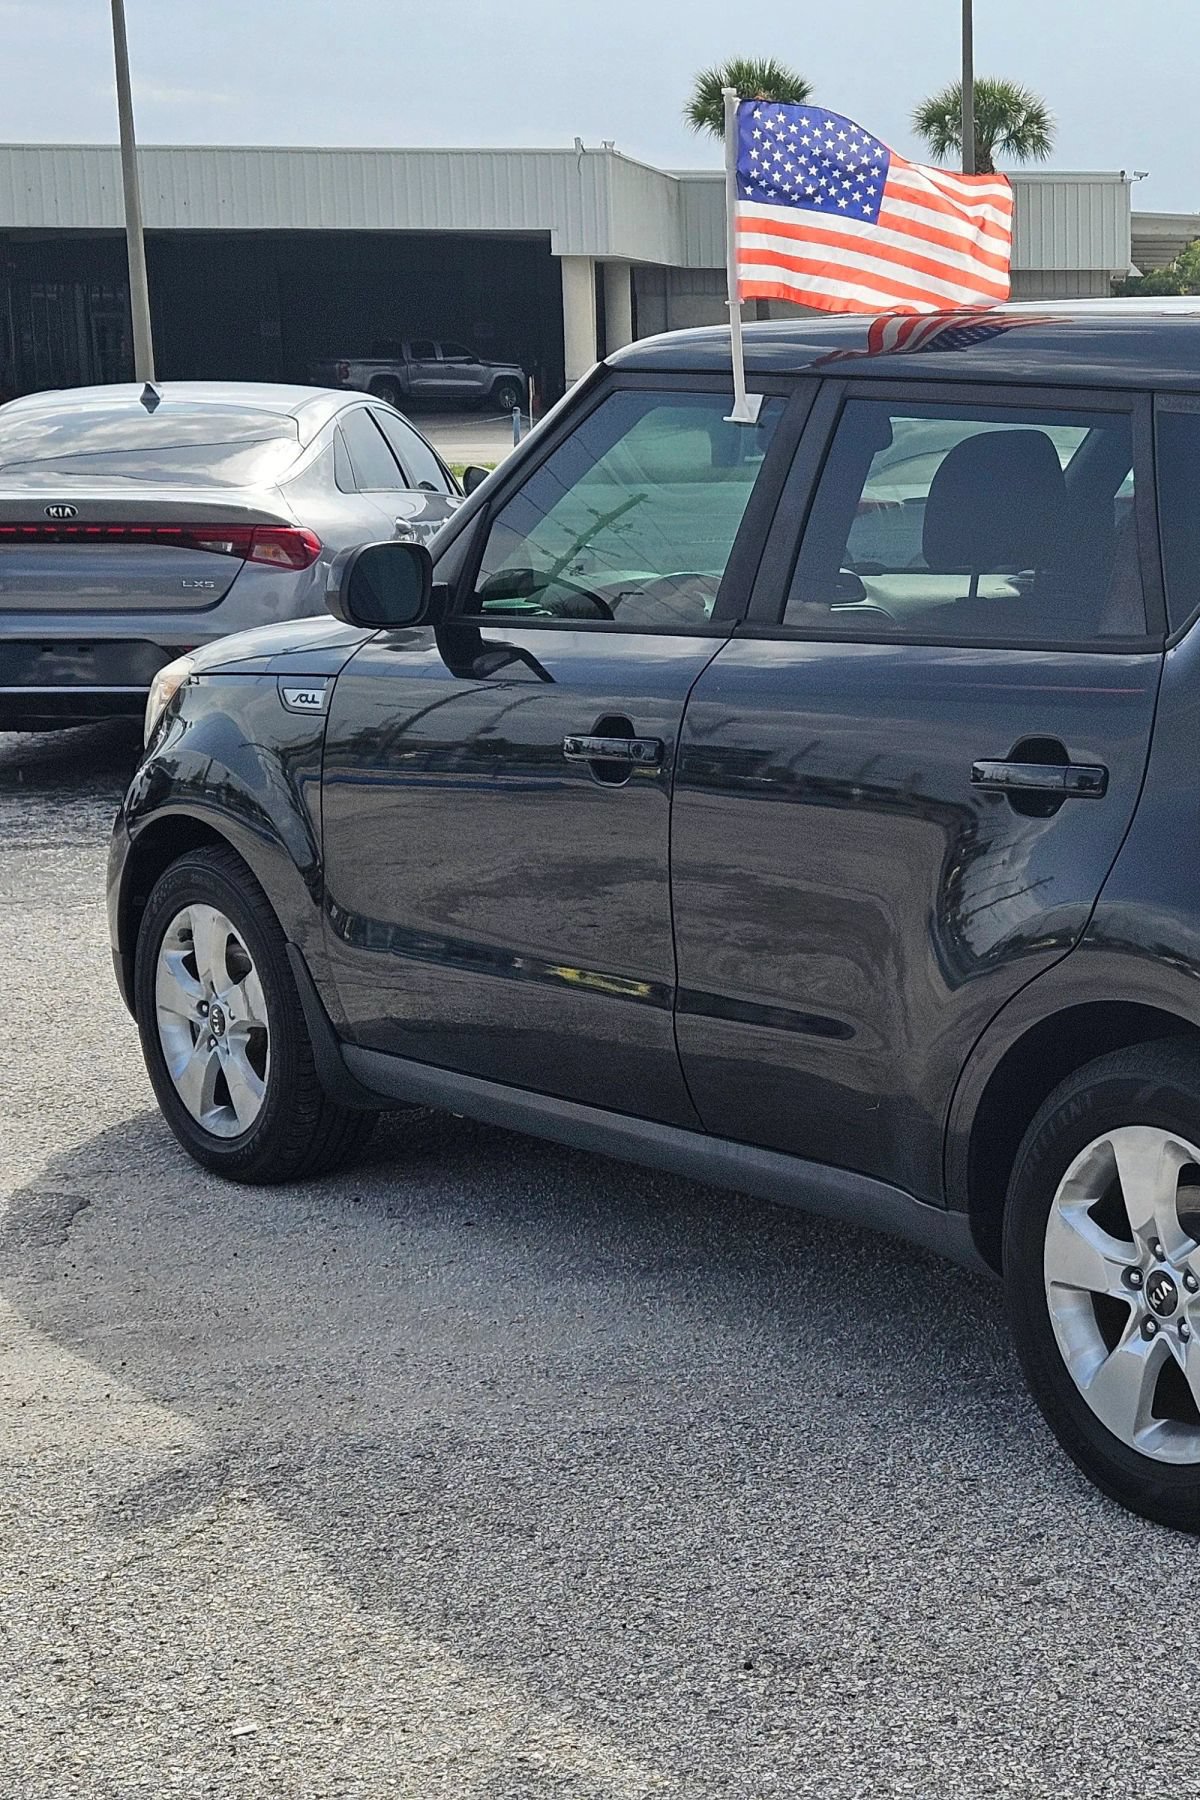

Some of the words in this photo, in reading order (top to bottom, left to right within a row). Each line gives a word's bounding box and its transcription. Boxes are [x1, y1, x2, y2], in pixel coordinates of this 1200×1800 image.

[49, 507, 73, 517] KIA
[182, 580, 215, 588] LXS
[1149, 1280, 1173, 1309] KIA
